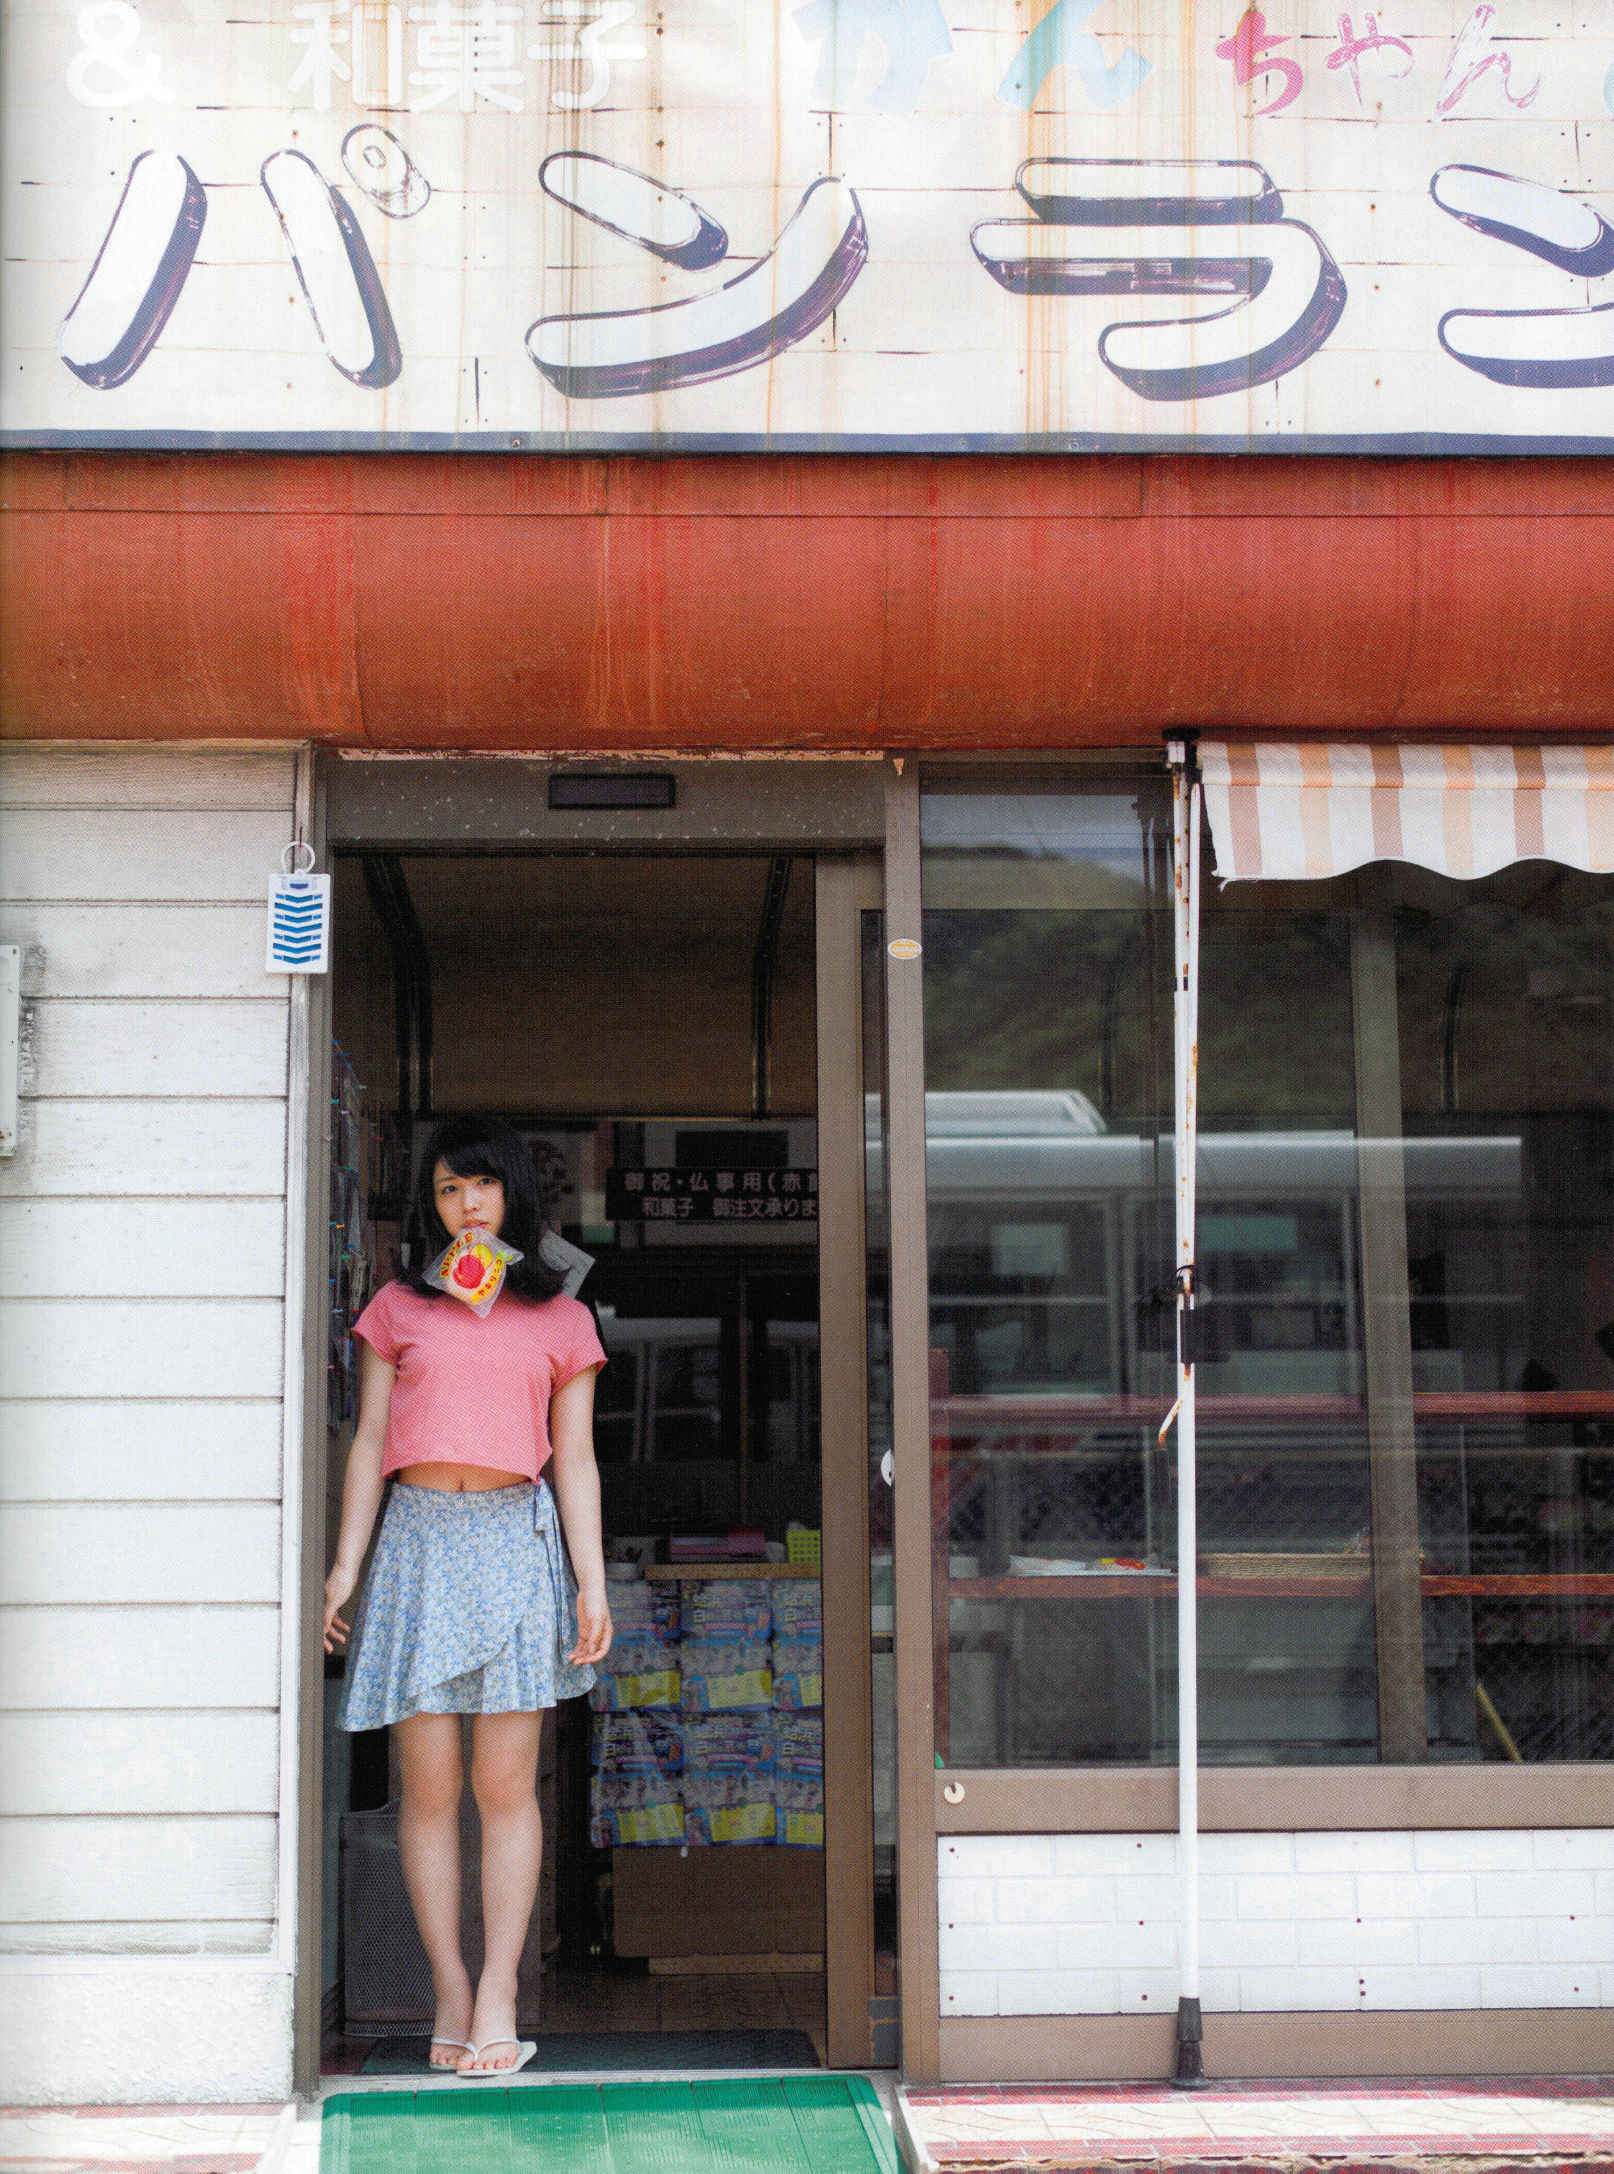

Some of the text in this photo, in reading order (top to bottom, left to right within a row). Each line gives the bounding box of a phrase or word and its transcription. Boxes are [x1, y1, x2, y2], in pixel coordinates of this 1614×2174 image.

[66, 0, 176, 107] &
[287, 0, 648, 112] 和菓子
[440, 1231, 474, 1278] APPLE
